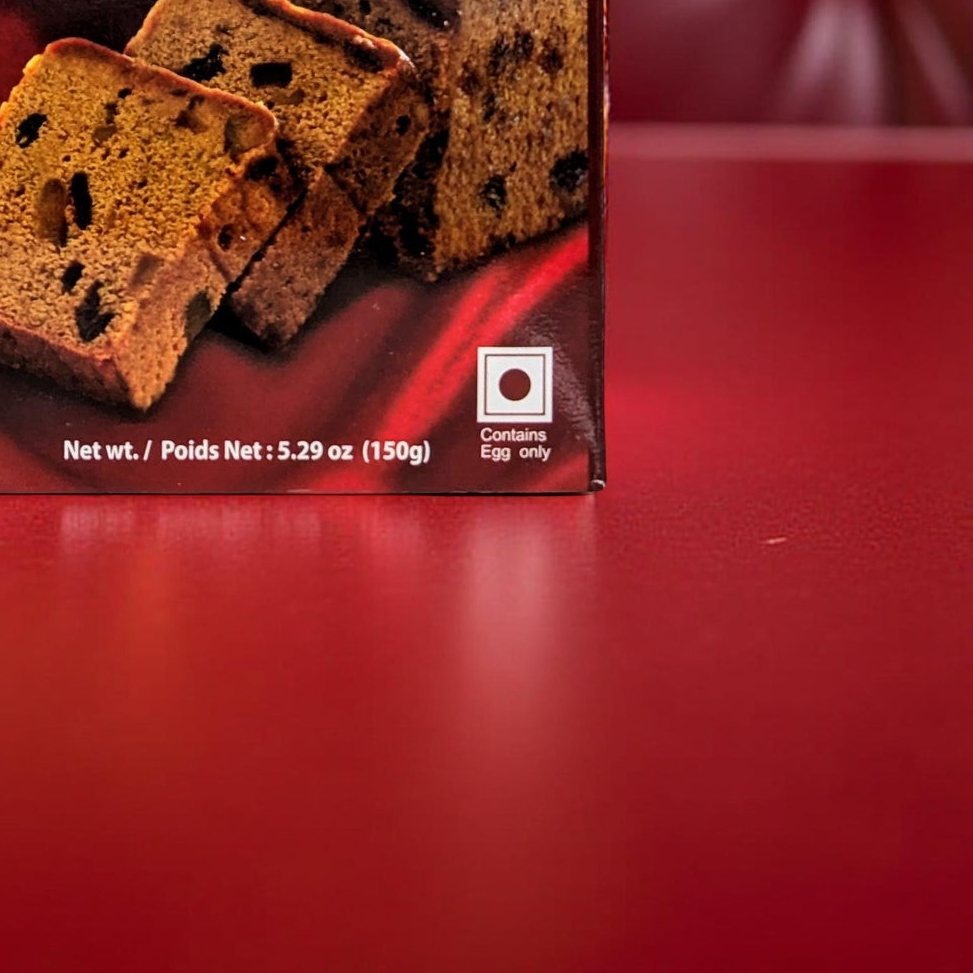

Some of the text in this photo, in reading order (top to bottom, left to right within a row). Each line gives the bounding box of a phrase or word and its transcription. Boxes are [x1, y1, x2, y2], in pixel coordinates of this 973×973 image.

[480, 427, 547, 443] Contains
[63, 440, 101, 461] Net
[105, 441, 139, 461] wt.
[143, 439, 152, 461] /
[161, 439, 220, 461] Poids
[224, 440, 262, 461] Net
[277, 440, 323, 461] 5.29
[328, 445, 353, 461] oz
[362, 439, 431, 465] (150g)
[480, 444, 551, 462] Egg only
